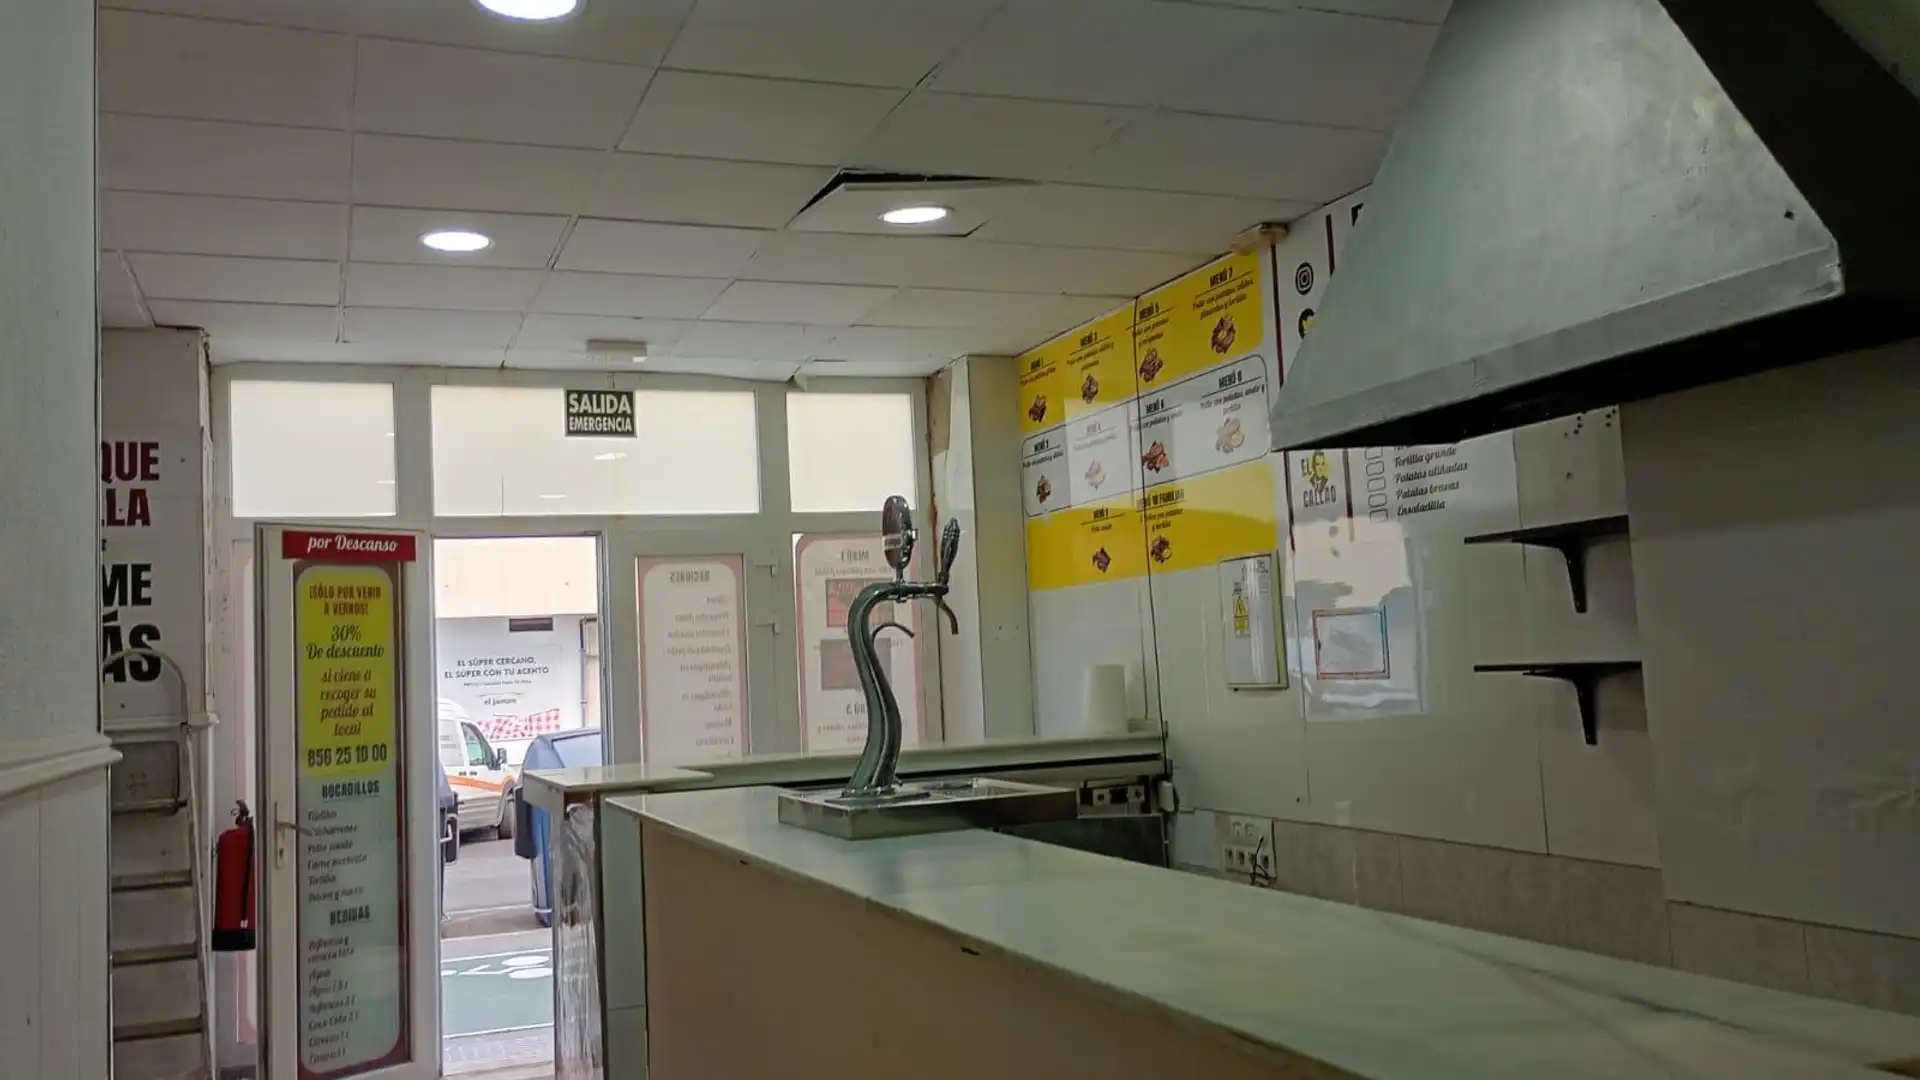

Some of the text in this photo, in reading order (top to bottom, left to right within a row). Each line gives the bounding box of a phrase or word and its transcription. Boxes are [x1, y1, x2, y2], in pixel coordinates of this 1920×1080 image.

[1210, 269, 1227, 287] MENÚ
[1218, 373, 1236, 389] MENÚ
[569, 393, 632, 414] SALIDA
[570, 416, 632, 432] EMERGENCIA
[1394, 446, 1456, 468] Tortilla grande
[1301, 458, 1312, 478] EL
[1394, 470, 1426, 484] Patatas
[1396, 480, 1460, 500] Patatas bravas
[1397, 500, 1446, 516] Ensaladilla
[308, 533, 398, 554] por Descanso
[310, 582, 380, 600] ¡SÓLO POR VENIR
[324, 602, 368, 616] A VERNOS!
[331, 624, 362, 642] 30%
[306, 643, 384, 660] De descuento
[468, 658, 494, 666] SÚPER
[496, 656, 537, 665] CERCANO,
[321, 668, 371, 683] si viene a
[455, 669, 481, 678] SÚPER
[483, 669, 501, 677] CON
[504, 668, 515, 676] TU
[517, 666, 549, 675] ACENTO
[320, 687, 376, 704] recoger su
[320, 703, 374, 722] pedido al
[334, 722, 361, 736] local
[308, 744, 387, 767] 856 25 10 00
[322, 780, 380, 798] BOCADILLOS
[330, 904, 370, 926] BEBIDAS
[309, 968, 331, 981] Agua
[309, 1019, 328, 1030] Coca
[329, 1015, 347, 1027] Cola
